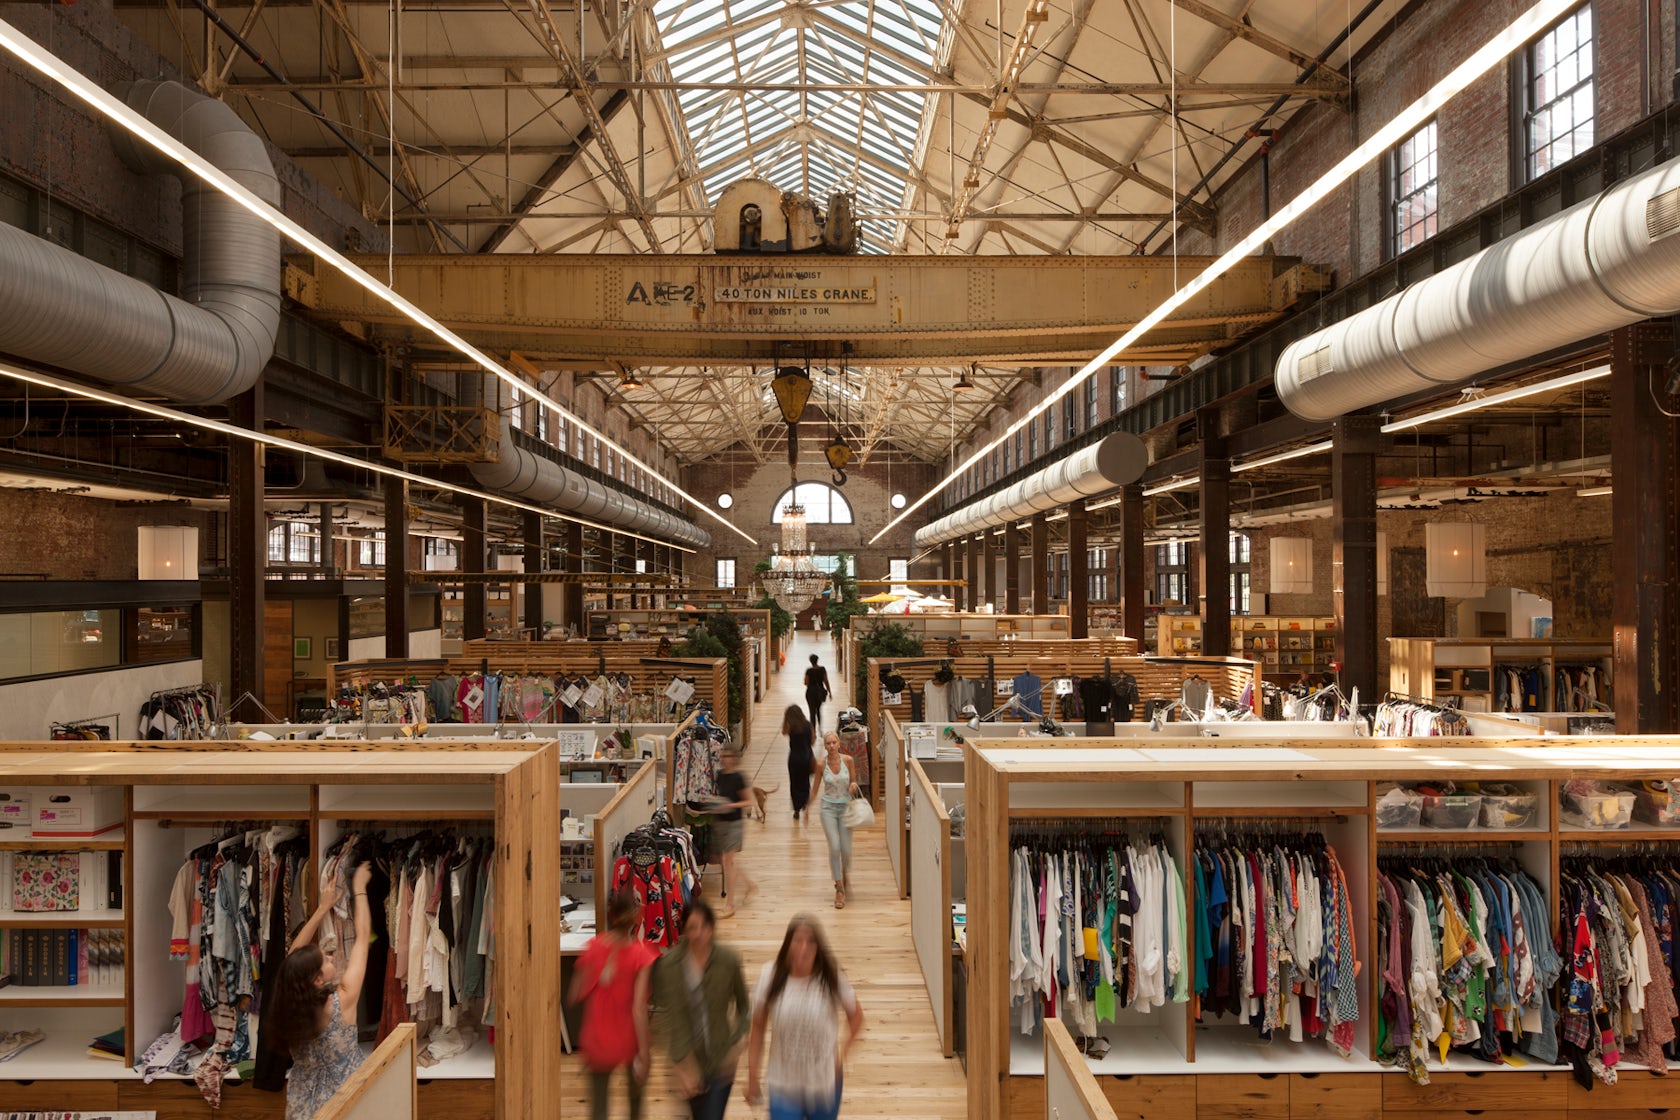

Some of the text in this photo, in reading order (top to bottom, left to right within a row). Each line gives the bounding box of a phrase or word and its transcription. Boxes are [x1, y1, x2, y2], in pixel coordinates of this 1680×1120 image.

[721, 289, 740, 299] 40
[744, 289, 771, 299] TON
[777, 289, 817, 299] NILES
